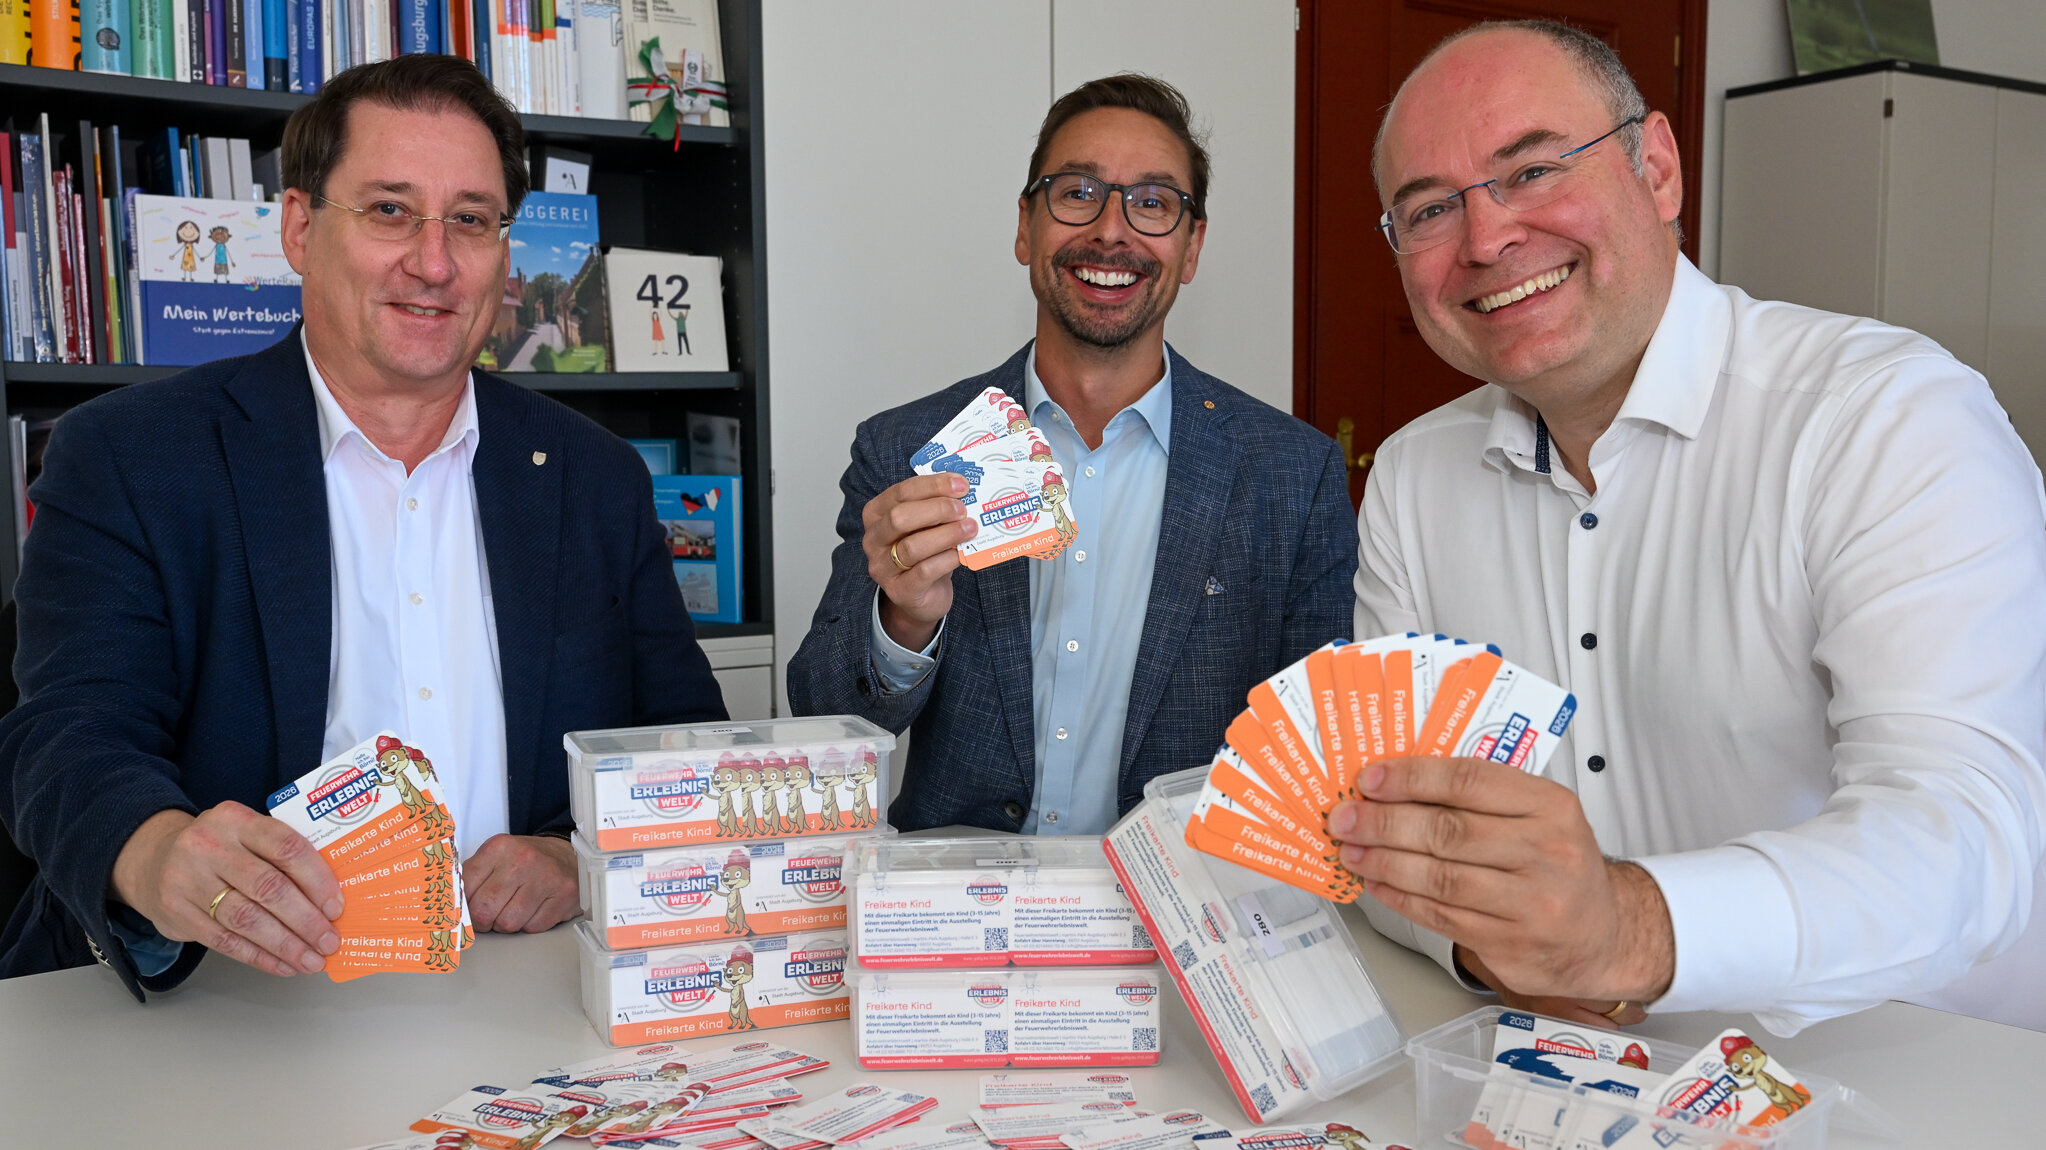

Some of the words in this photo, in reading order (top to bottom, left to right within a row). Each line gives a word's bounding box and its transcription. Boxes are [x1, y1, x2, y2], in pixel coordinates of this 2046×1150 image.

[306, 6, 315, 50] EUROPAS
[636, 274, 691, 311] 42
[163, 305, 208, 321] Mein
[212, 306, 302, 323] Wertebuch
[927, 447, 945, 460] 2026
[984, 493, 1026, 511] FEUERWEHR
[982, 498, 1040, 525] ERLEBNIS
[1006, 514, 1030, 528] WELT
[992, 542, 1032, 560] Freikarte
[1034, 534, 1055, 547] Kind
[1321, 689, 1342, 752] Freikarte
[1348, 690, 1368, 752] Freikarte
[1367, 693, 1385, 755] Freikarte
[1393, 690, 1407, 752] Freikarte
[1437, 688, 1477, 747] Freikarte
[1552, 706, 1572, 734] 2026
[1259, 745, 1303, 797] Freikarte
[1271, 719, 1310, 776] Freikarte
[1306, 775, 1331, 806] Kind
[310, 769, 360, 801] FEUERWEHR
[632, 779, 707, 798] ERLEBNIS
[274, 786, 297, 803] 2026
[309, 771, 379, 819] ERLEBNIS
[660, 796, 690, 807] WELT
[340, 793, 369, 815] WELT
[1242, 788, 1296, 831] Freikarte
[329, 830, 378, 860] Freikarte
[378, 812, 404, 831] Kind
[394, 824, 419, 841] Kind
[632, 830, 683, 843] Freikarte
[687, 826, 712, 837] Kind
[1141, 815, 1166, 856] Freikarte
[1164, 856, 1179, 879] Kind
[1241, 825, 1300, 858] Freikarte
[790, 857, 840, 868] FEUERWEHR
[1232, 842, 1292, 871] Freikarte
[393, 858, 420, 873] Kind
[650, 867, 702, 879] FEUERWEHR
[643, 878, 716, 896] ERLEBNIS
[810, 881, 838, 893] WELT
[967, 886, 1007, 895] ERLEBNIS
[670, 893, 700, 905] WELT
[865, 900, 907, 909] Freikarte
[910, 900, 931, 909] Kind
[1015, 896, 1057, 905] Freikarte
[1060, 896, 1081, 905] Kind
[782, 914, 830, 927] Freikarte
[1253, 913, 1271, 937] 280
[641, 927, 692, 940] Freikarte
[695, 923, 720, 934] Kind
[397, 937, 423, 948] Kind
[793, 949, 842, 961] FEUERWEHR
[654, 964, 706, 977] FEUERWEHR
[647, 973, 719, 993] ERLEBNIS
[811, 974, 839, 985] WELT
[1219, 953, 1245, 997] Freikarte
[1243, 997, 1259, 1020] Kind
[674, 990, 703, 1002] WELT
[968, 989, 1007, 997] ERLEBNIS
[1117, 987, 1156, 995] ERLEBNIS
[866, 1002, 908, 1011] Freikarte
[911, 1002, 932, 1010] Kind
[1015, 999, 1057, 1007] Freikarte
[1060, 999, 1081, 1007] Kind
[785, 1007, 832, 1019] Freikarte
[645, 1025, 695, 1037] Freikarte
[699, 1019, 723, 1030] Kind
[1509, 1015, 1533, 1029] 2026
[1537, 1041, 1595, 1060] FEUERWEHR
[1608, 1084, 1637, 1098] 2026
[477, 1105, 543, 1121] ERLEBNIS
[494, 1099, 541, 1113] FEUERWEHR
[490, 1117, 520, 1127] WELT
[1243, 1133, 1303, 1143] FEUERWEHR
